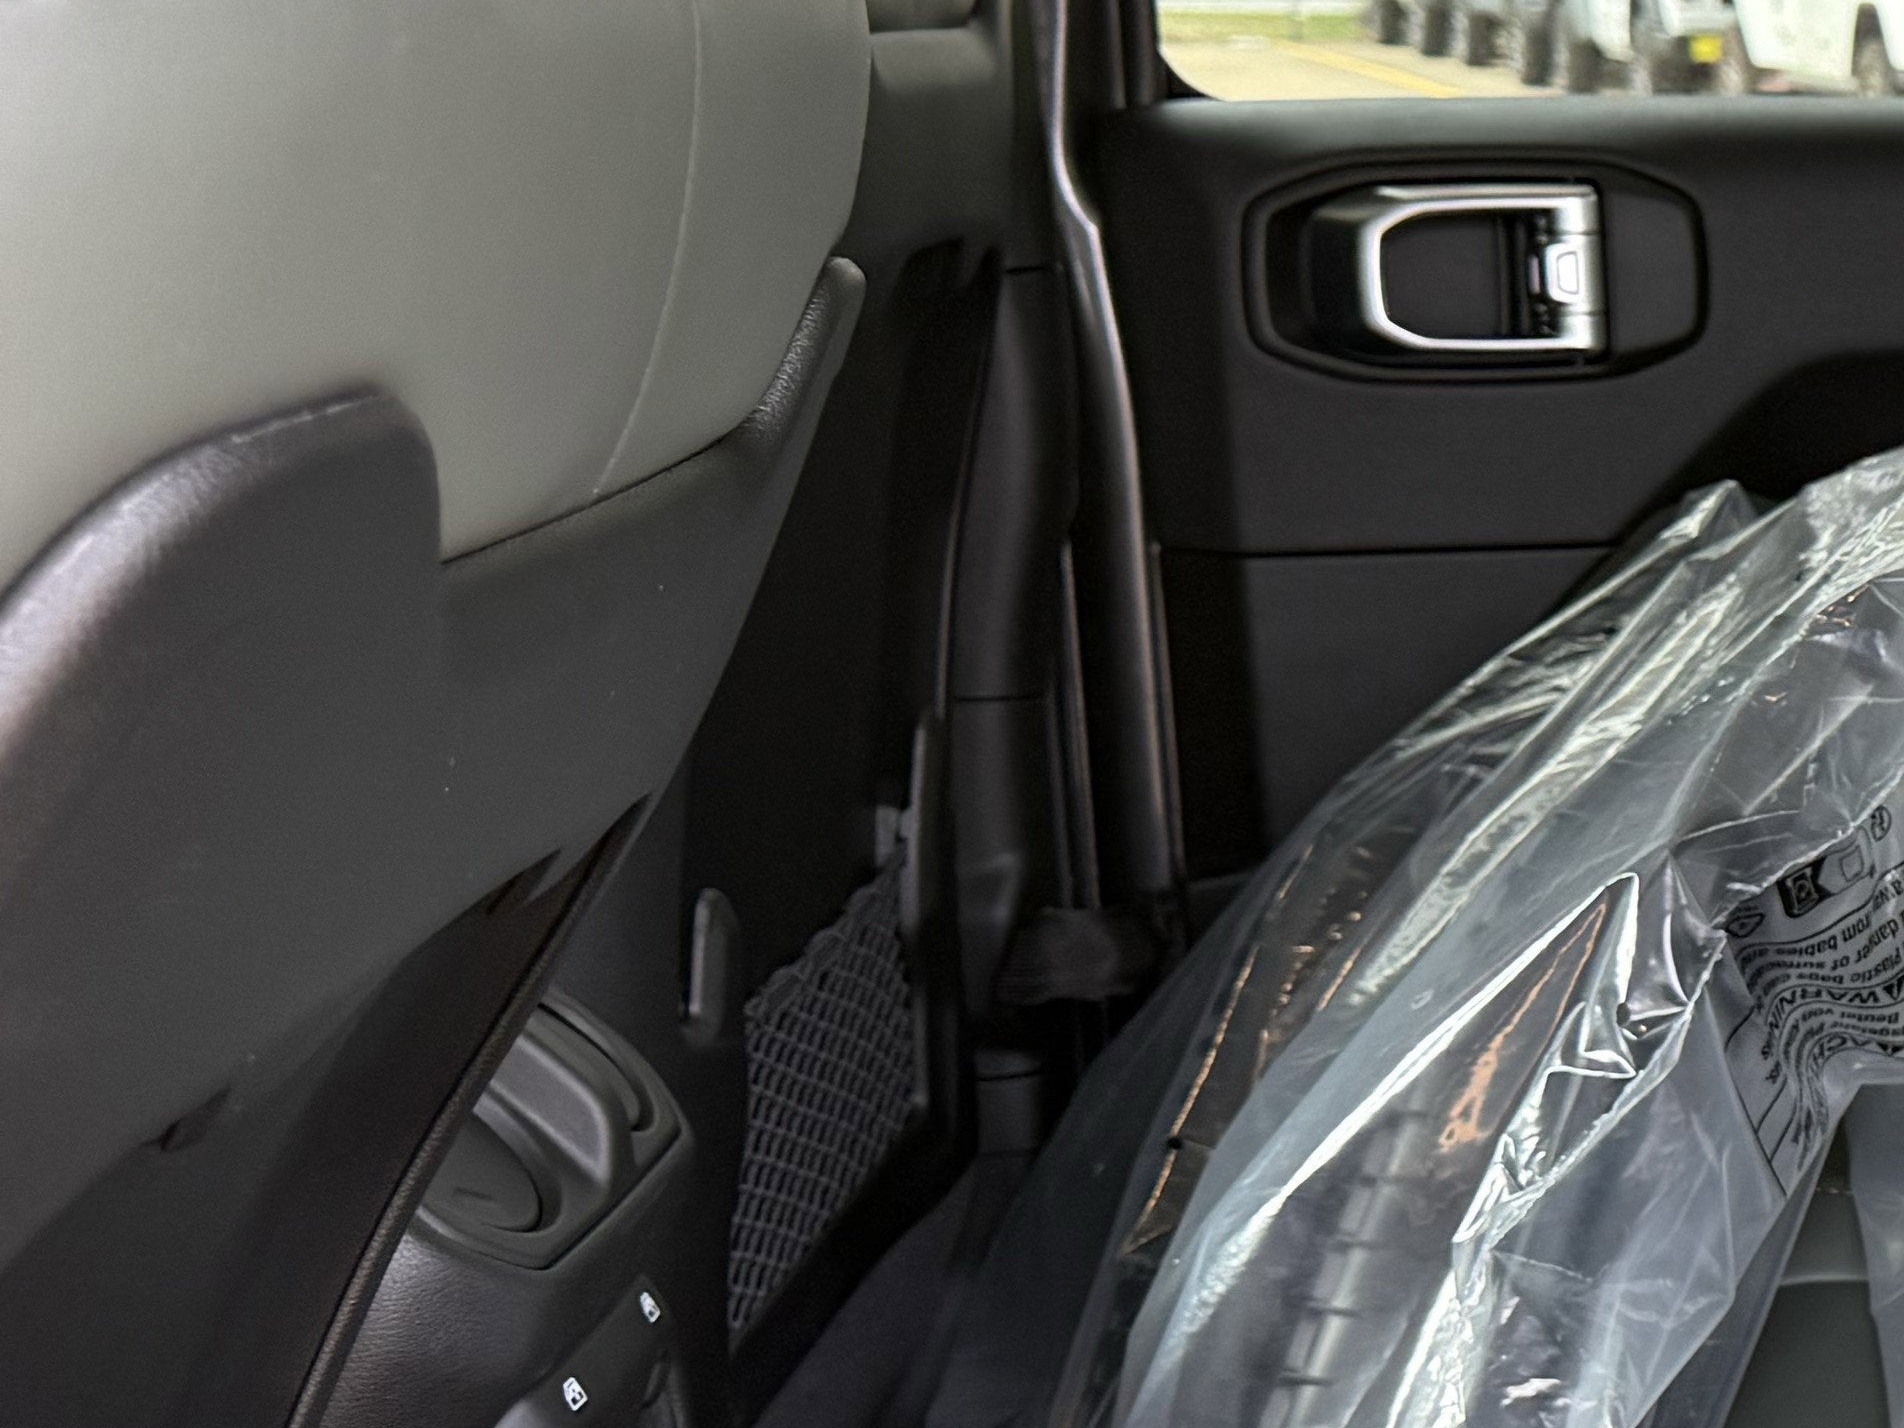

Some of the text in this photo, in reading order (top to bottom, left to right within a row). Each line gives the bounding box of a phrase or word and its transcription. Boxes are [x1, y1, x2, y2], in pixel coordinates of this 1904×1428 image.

[1841, 916, 1873, 944] rom
[1830, 955, 1850, 972] of
[1849, 945, 1903, 985] Plastic
